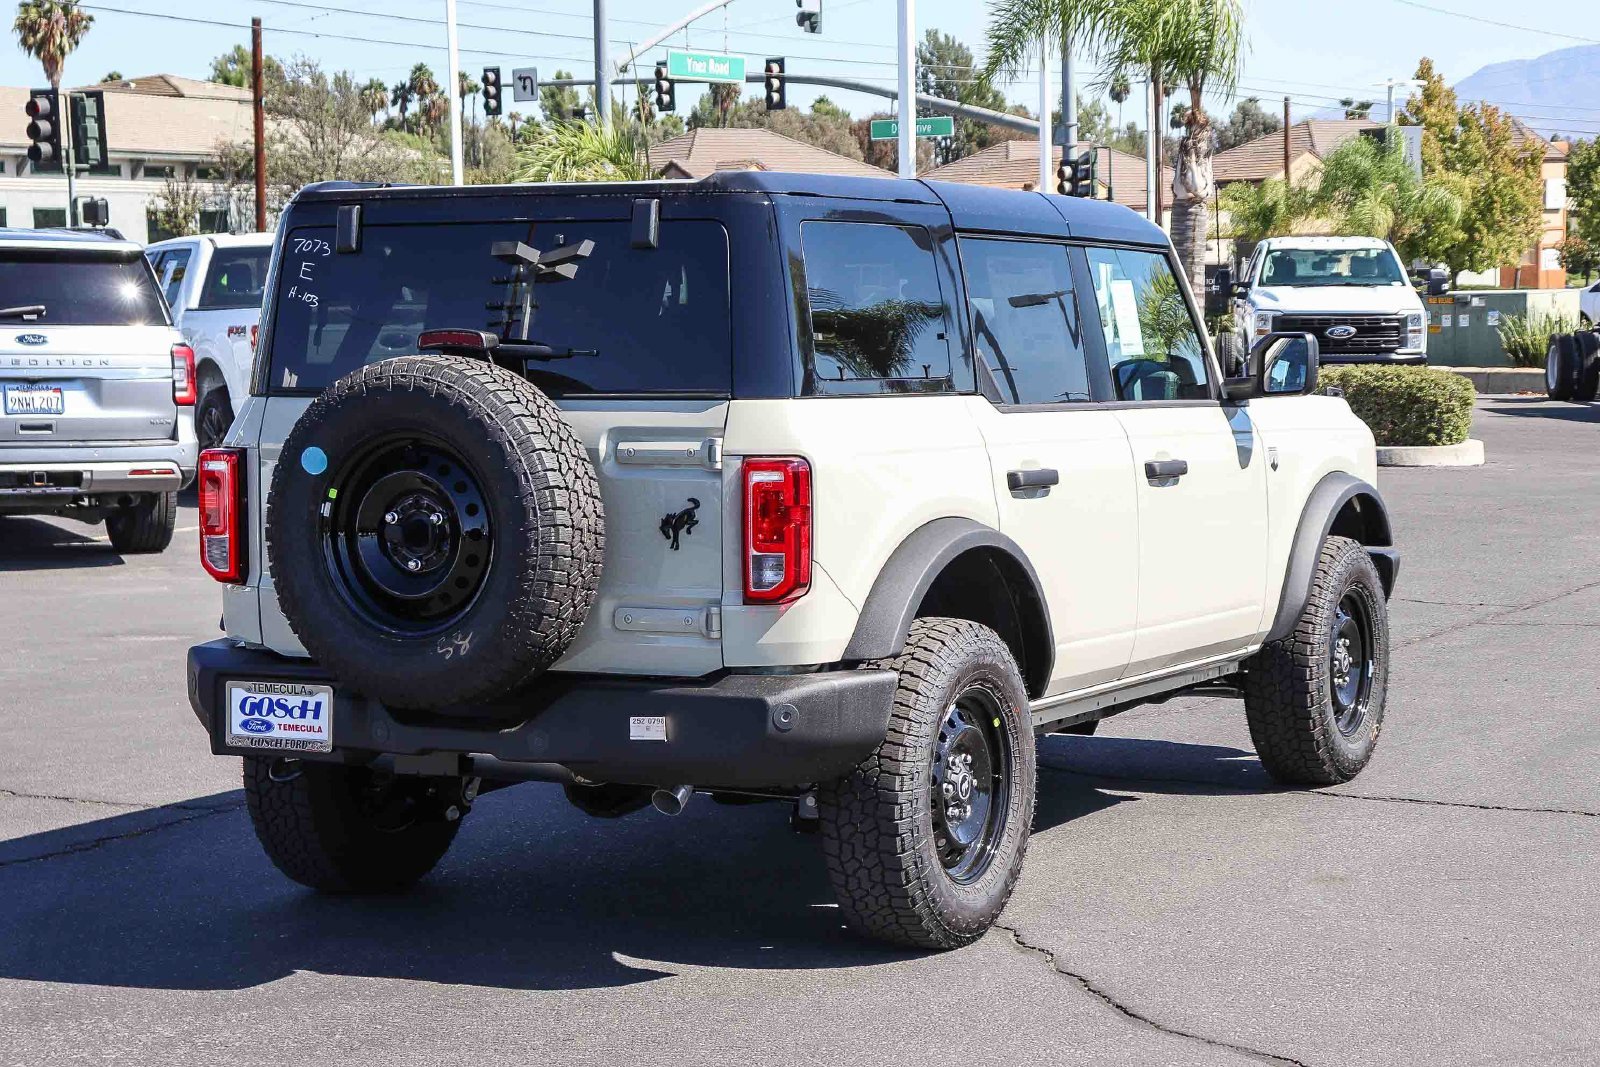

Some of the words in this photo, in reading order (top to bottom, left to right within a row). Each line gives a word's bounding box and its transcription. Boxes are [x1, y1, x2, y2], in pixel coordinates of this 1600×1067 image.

[708, 58, 730, 75] Road
[916, 123, 932, 134] rive
[294, 238, 331, 256] 7073
[299, 261, 316, 281] E
[0, 359, 109, 367] EDITION
[251, 683, 307, 696] TEMECULA
[277, 723, 323, 734] TEMECULA
[284, 740, 308, 750] FORD
